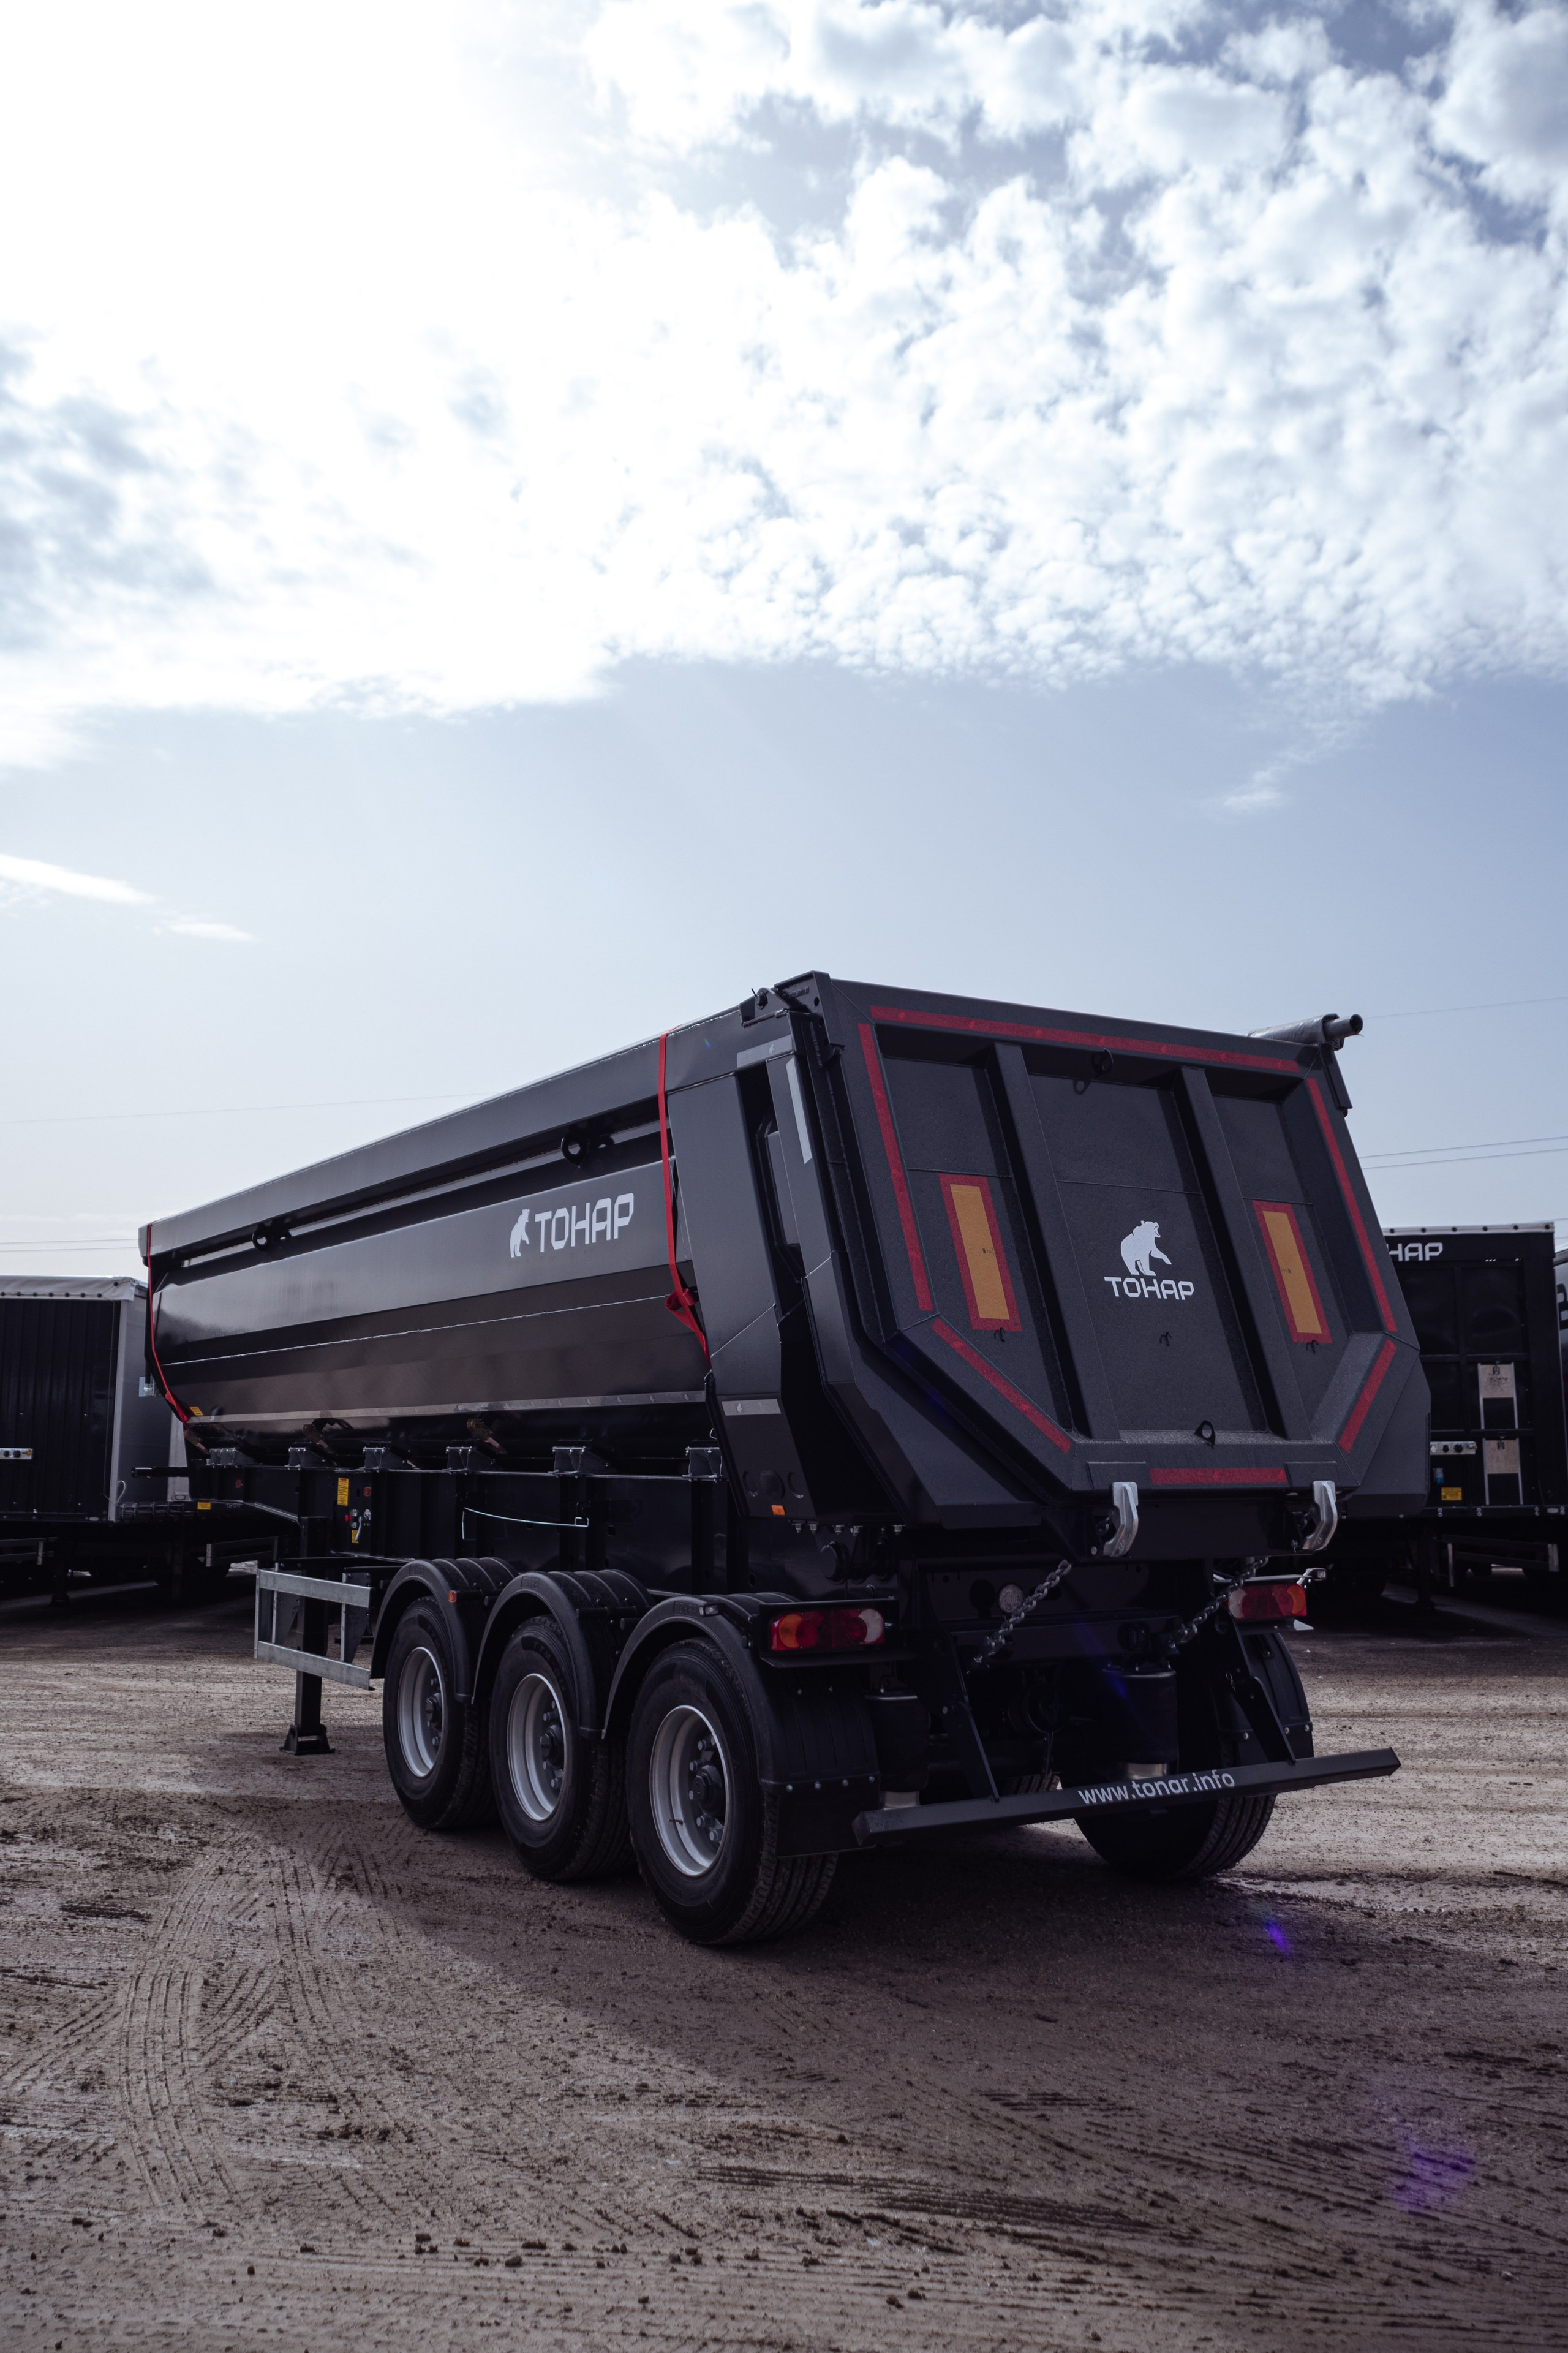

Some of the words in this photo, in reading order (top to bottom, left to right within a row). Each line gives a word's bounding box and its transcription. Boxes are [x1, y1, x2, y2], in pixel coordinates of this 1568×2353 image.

[535, 1193, 634, 1253] ТОНАР
[1104, 1277, 1194, 1300] ТОНАР
[1077, 1769, 1235, 1805] www.tonar.info
